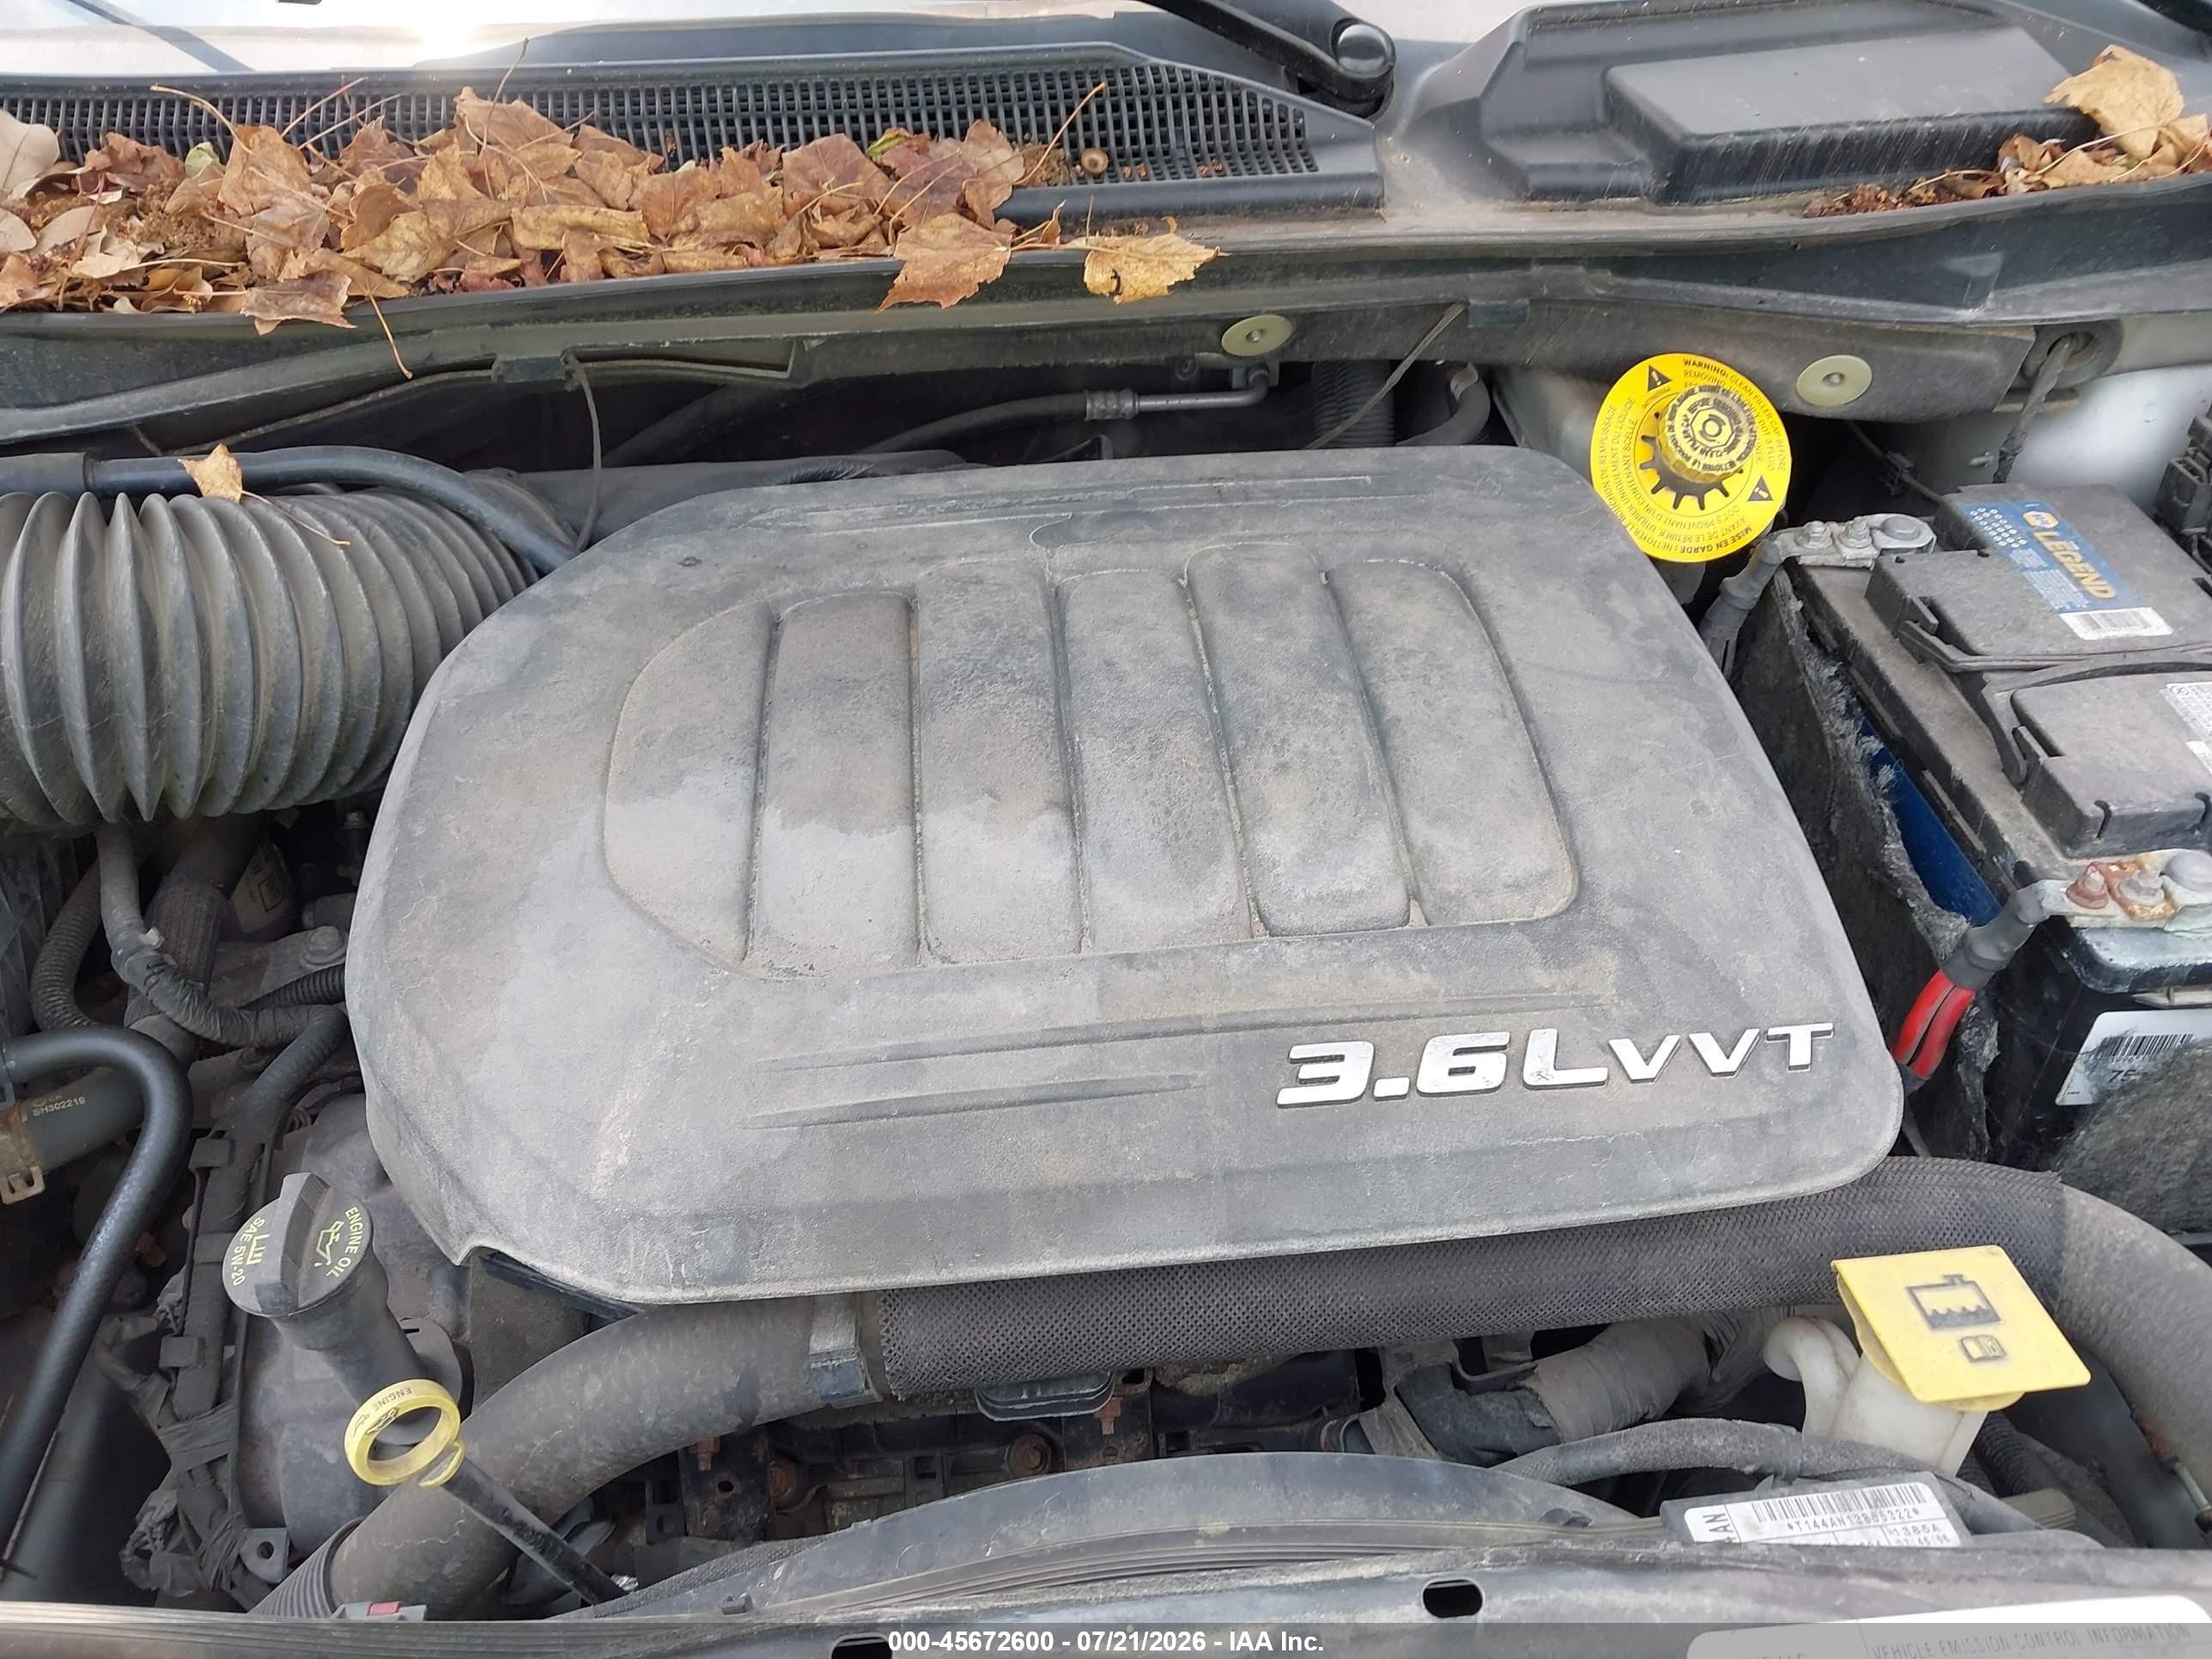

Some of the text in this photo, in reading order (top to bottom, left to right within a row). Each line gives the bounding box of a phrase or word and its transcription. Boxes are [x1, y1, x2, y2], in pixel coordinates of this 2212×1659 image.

[1715, 538, 1729, 550] EN
[1729, 523, 1753, 544] MISE
[1679, 543, 1714, 554] GARDE
[2033, 531, 2116, 598] LEGEND
[240, 1217, 265, 1243] SAE
[325, 1206, 363, 1278] ENGINE OIL
[372, 1387, 412, 1412] ENGINE
[1870, 1622, 2192, 1659] VEHICLE EMISSION CONTROL INFORMATION
